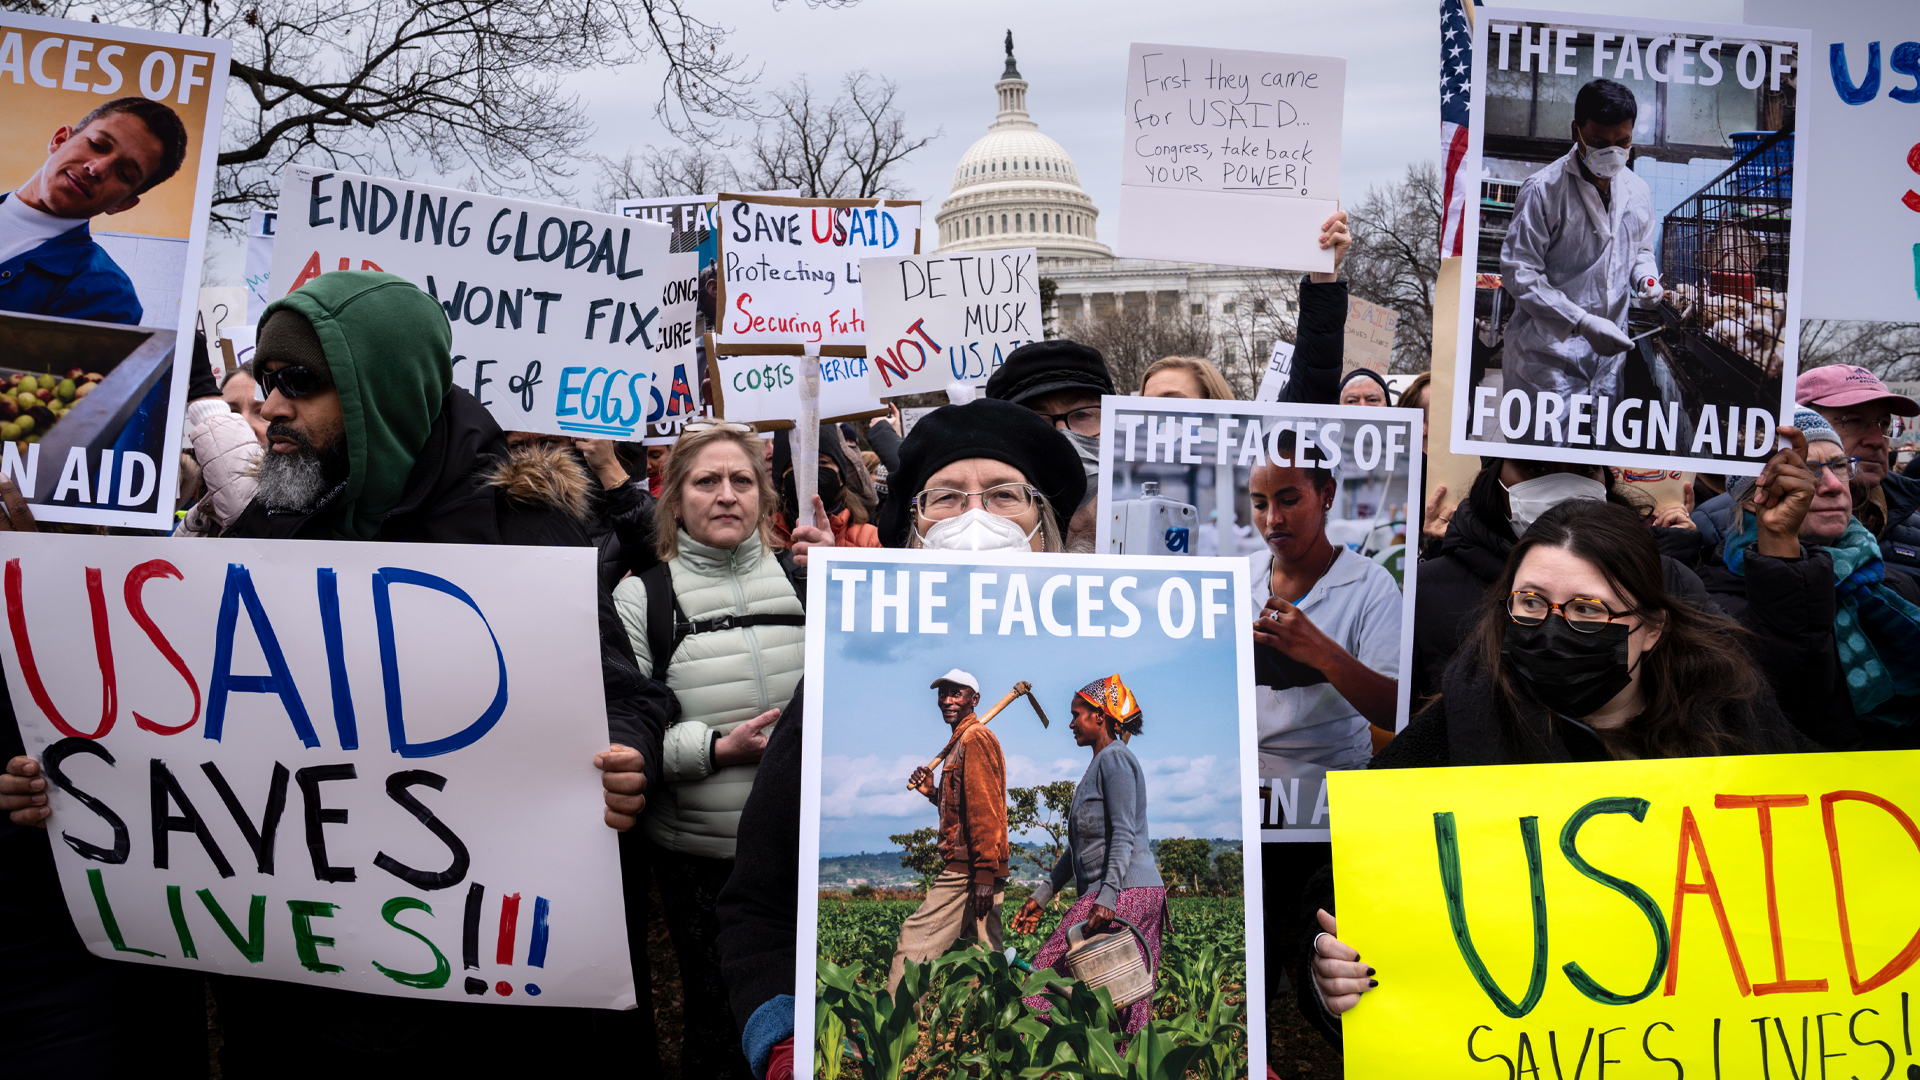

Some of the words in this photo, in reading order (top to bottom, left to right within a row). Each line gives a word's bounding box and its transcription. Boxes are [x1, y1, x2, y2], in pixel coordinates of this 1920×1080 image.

[138, 50, 209, 106] OF
[1142, 52, 1192, 97] First
[1204, 57, 1250, 105] they
[1260, 68, 1319, 91] came
[1491, 23, 1578, 76] THE
[1593, 31, 1724, 88] FACES
[1735, 40, 1792, 92] OF
[1133, 98, 1173, 130] for
[1187, 98, 1312, 130] USAID...
[1135, 134, 1214, 165] Congress,
[1220, 136, 1260, 158] take
[1265, 138, 1314, 165] back
[1144, 163, 1204, 184] YOUR
[1221, 162, 1309, 197] POWER!
[308, 172, 474, 248] ENDING
[486, 206, 644, 281] GLOBAL
[732, 202, 802, 246] SAVE
[811, 207, 900, 249] USAID
[726, 251, 836, 296] Protecting
[899, 253, 1038, 302] DETUSK
[426, 274, 562, 334] WON'T
[583, 297, 659, 350] FIX
[733, 292, 823, 343] Securing
[964, 301, 1031, 338] MUSK
[873, 316, 943, 389] NOT
[507, 359, 544, 413] of
[555, 366, 648, 428] EGGS
[1470, 385, 1680, 453] FOREIGN
[1690, 402, 1777, 459] AID
[1117, 413, 1204, 466] THE
[1217, 418, 1343, 471] FACES
[1352, 422, 1408, 473] OF
[53, 445, 157, 507] AID
[831, 567, 949, 635] THE
[969, 572, 1143, 639] FACES
[1156, 576, 1229, 640] OF
[4, 557, 509, 760] USAID
[41, 736, 471, 892] SAVES
[86, 867, 552, 999] LIVES!!!
[1433, 788, 1920, 1020] USAID
[1467, 1020, 1684, 1080] SAVES
